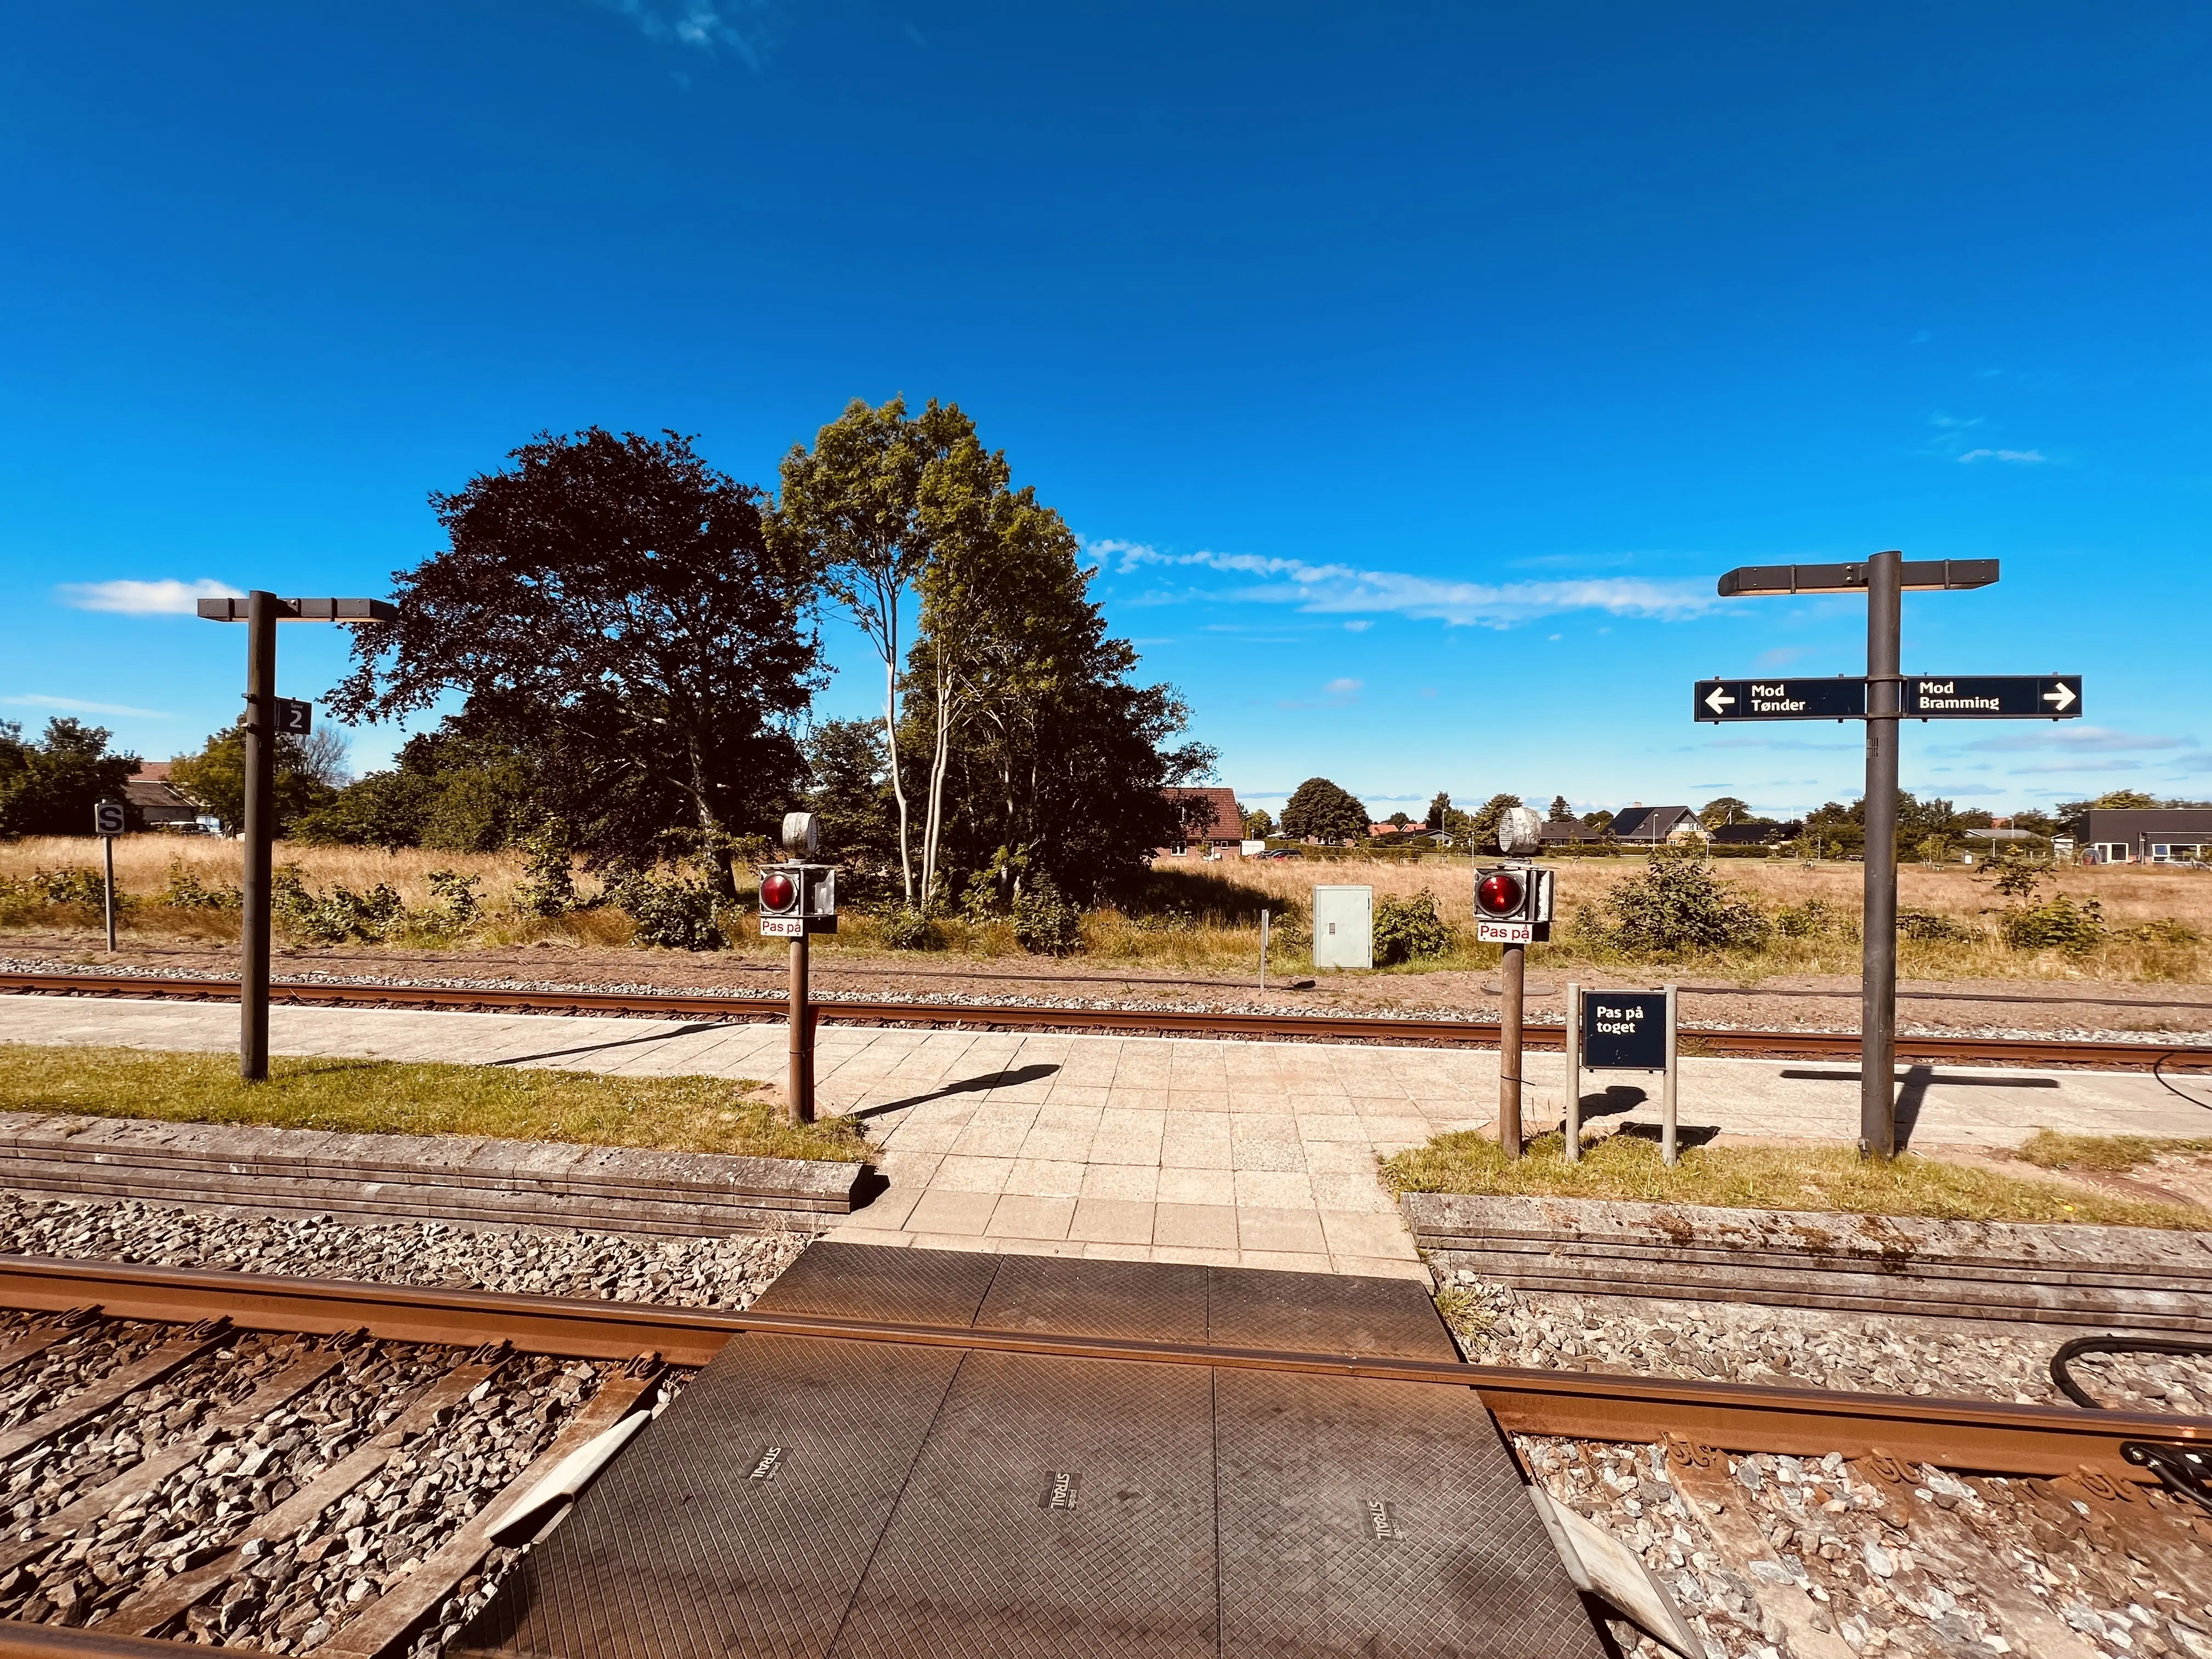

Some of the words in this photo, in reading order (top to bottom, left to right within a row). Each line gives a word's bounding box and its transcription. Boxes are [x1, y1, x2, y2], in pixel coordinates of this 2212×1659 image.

[1752, 684, 1785, 697] Mod
[1920, 681, 1954, 694] Mod
[1751, 698, 1806, 712] Tønder
[1920, 696, 2000, 710] Bramming
[290, 710, 302, 728] 2
[99, 806, 122, 832] S
[763, 921, 783, 932] Pas
[787, 921, 801, 934] på
[1480, 926, 1507, 938] Pas
[1512, 926, 1530, 941] på
[1597, 1006, 1622, 1018] Pas
[1626, 1006, 1644, 1020] på
[1596, 1022, 1635, 1035] toget
[749, 1447, 781, 1480] STRAIL
[1050, 1473, 1070, 1509] STRAIL
[1369, 1501, 1392, 1539] STRAIL
